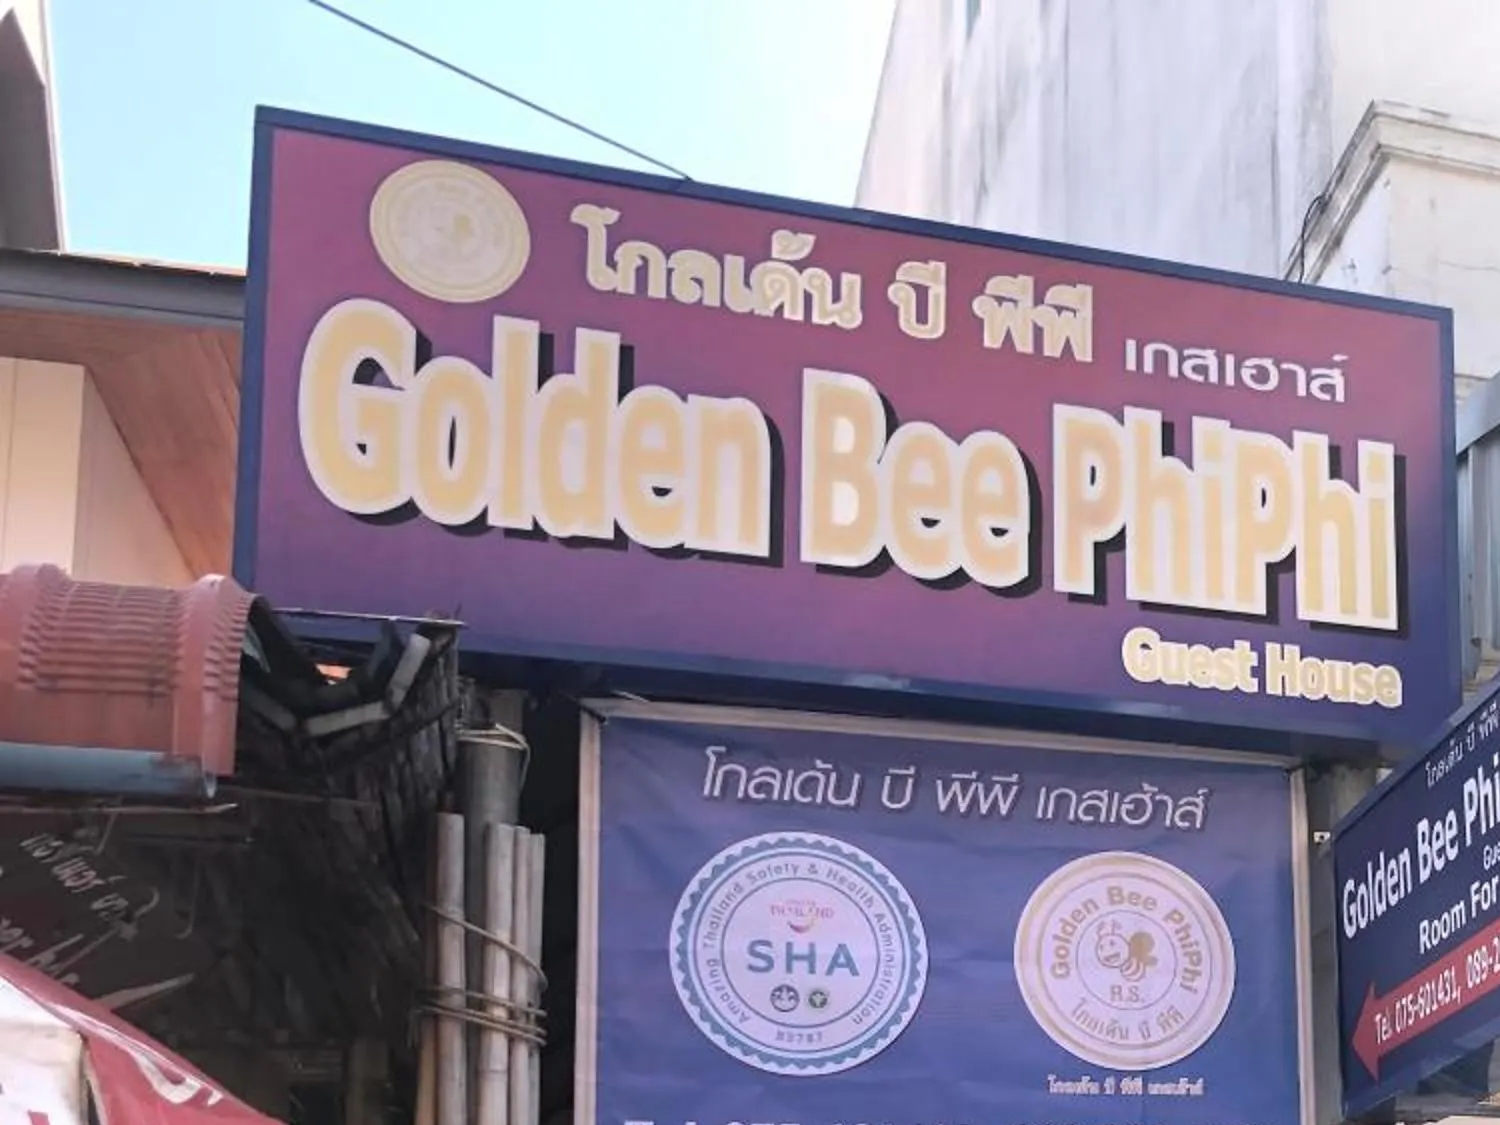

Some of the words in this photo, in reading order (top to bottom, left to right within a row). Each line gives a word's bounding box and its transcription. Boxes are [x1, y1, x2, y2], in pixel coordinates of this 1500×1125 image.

[571, 203, 863, 329] โกลเด้น
[1125, 337, 1348, 404] เกสเฮาส์
[298, 297, 775, 560] Golden
[799, 366, 1032, 589] Bee
[1052, 401, 1399, 632] PhiPhi
[1121, 628, 1258, 698] Guest
[1265, 642, 1402, 708] House
[702, 746, 861, 807] โกลเด้น
[881, 765, 917, 810] บี
[935, 771, 1020, 815] พีพี
[1036, 782, 1210, 830] เกสเฮ้าส์
[1343, 847, 1413, 940] Golden
[1417, 809, 1460, 885] Bee
[1419, 899, 1467, 955] Room
[1469, 875, 1500, 918] For
[702, 882, 747, 950] Thailand
[746, 862, 800, 887] Safety
[807, 863, 819, 875] &
[825, 867, 876, 908] Health
[851, 911, 898, 1026] Administration
[746, 938, 860, 977] SHA
[1050, 897, 1100, 981] Golden
[1106, 885, 1158, 912] Bee
[1163, 908, 1204, 996] PhiPhi
